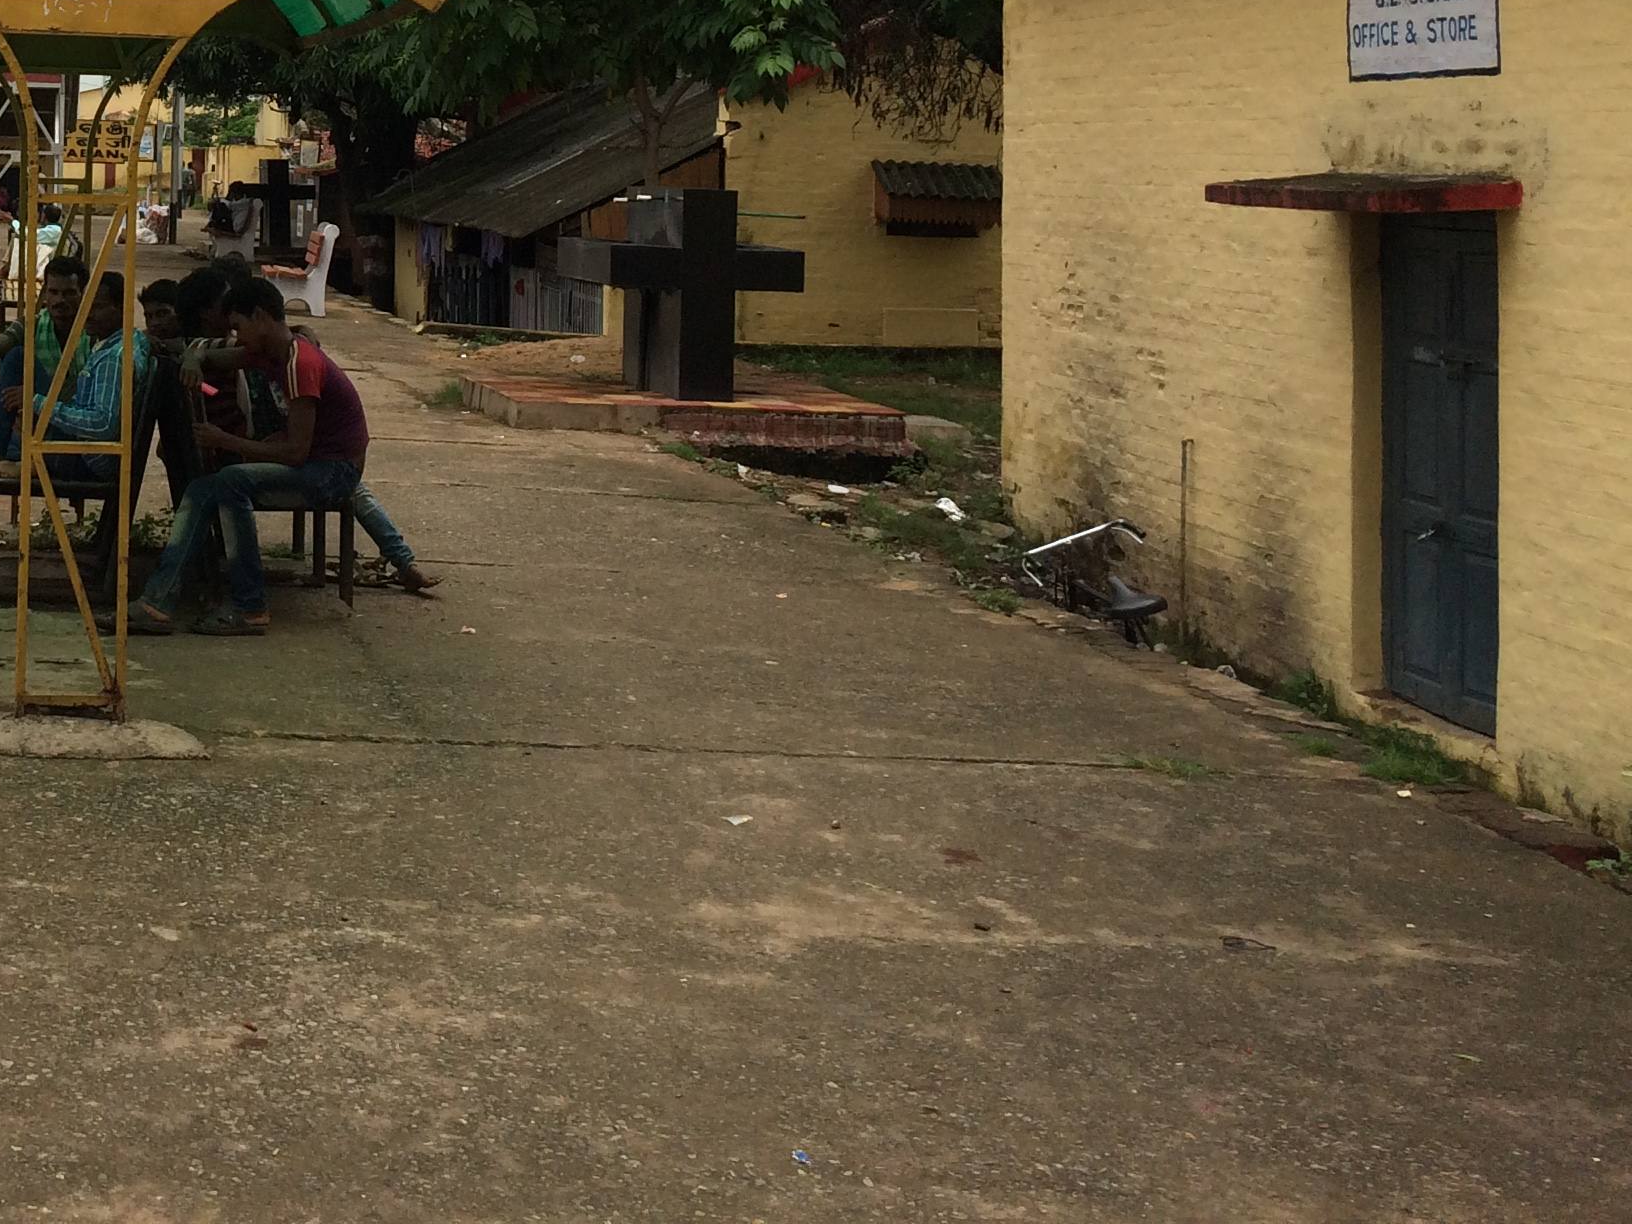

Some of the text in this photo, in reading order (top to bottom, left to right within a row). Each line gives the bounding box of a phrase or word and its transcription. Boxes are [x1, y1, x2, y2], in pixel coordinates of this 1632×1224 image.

[1352, 15, 1478, 48] OFFICE & STORE
